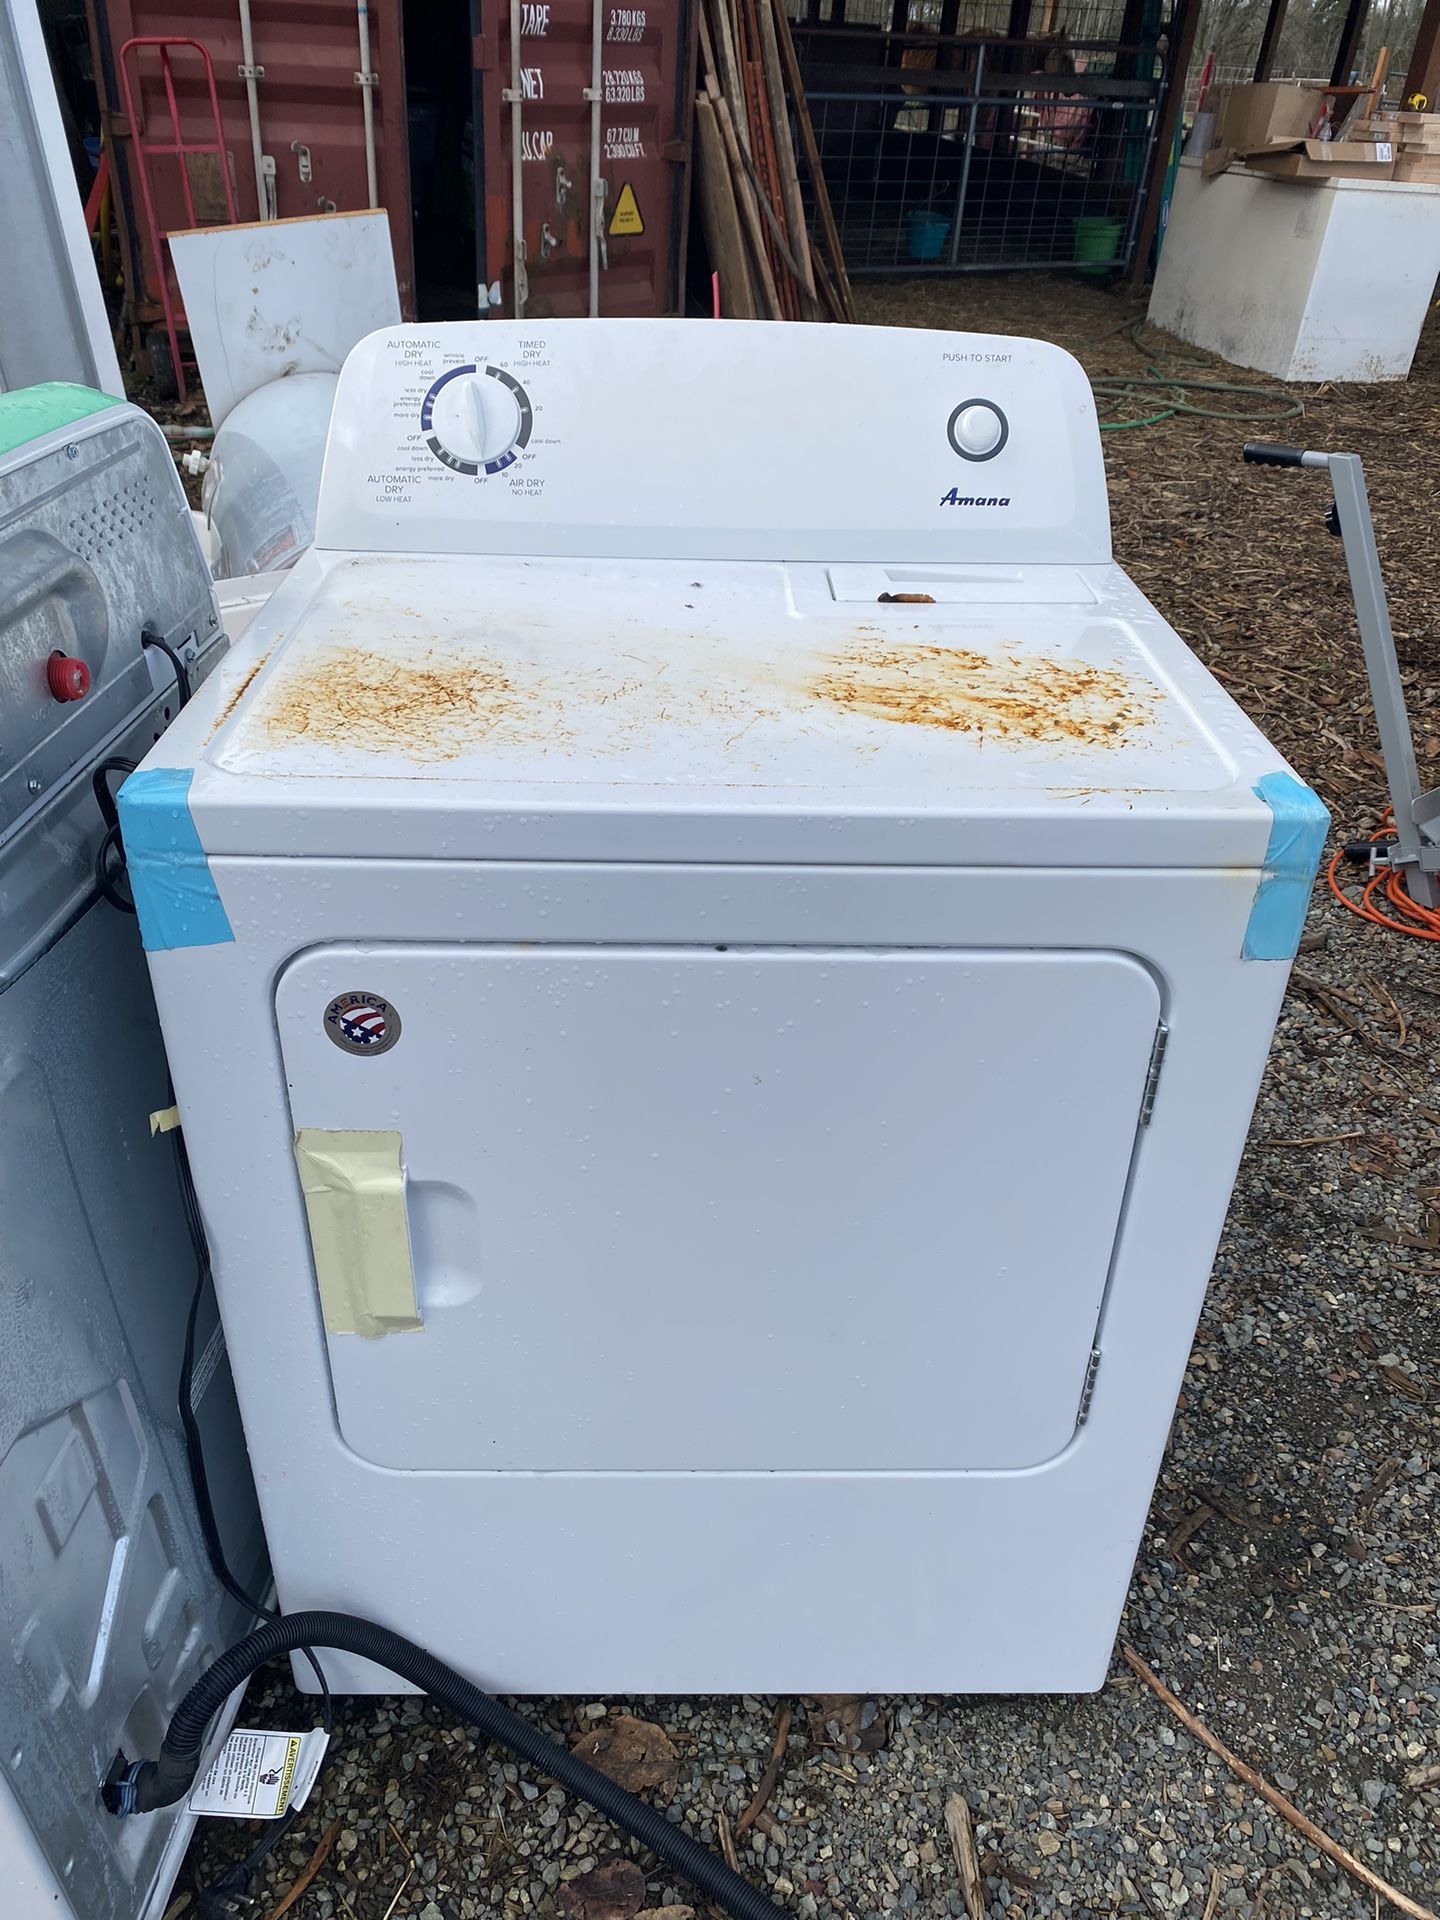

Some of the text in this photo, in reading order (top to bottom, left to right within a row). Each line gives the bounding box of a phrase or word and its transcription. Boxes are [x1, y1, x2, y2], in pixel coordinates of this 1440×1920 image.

[521, 4, 550, 35] TARE
[520, 68, 544, 99] NET
[521, 131, 553, 160] U.CAP
[387, 340, 441, 349] AUTOMATIC
[518, 340, 546, 349] TIMED
[404, 350, 423, 359] DRY
[522, 350, 542, 359] DRY
[942, 353, 1013, 363] PUSH TO START
[367, 475, 421, 484] AUTOMATIC
[509, 479, 545, 487] AIR DRY
[384, 485, 404, 494] DRY
[939, 487, 1011, 507] Amana
[328, 994, 387, 1025] AMERICA
[277, 1747, 298, 1812] AVERTISSEMENT
